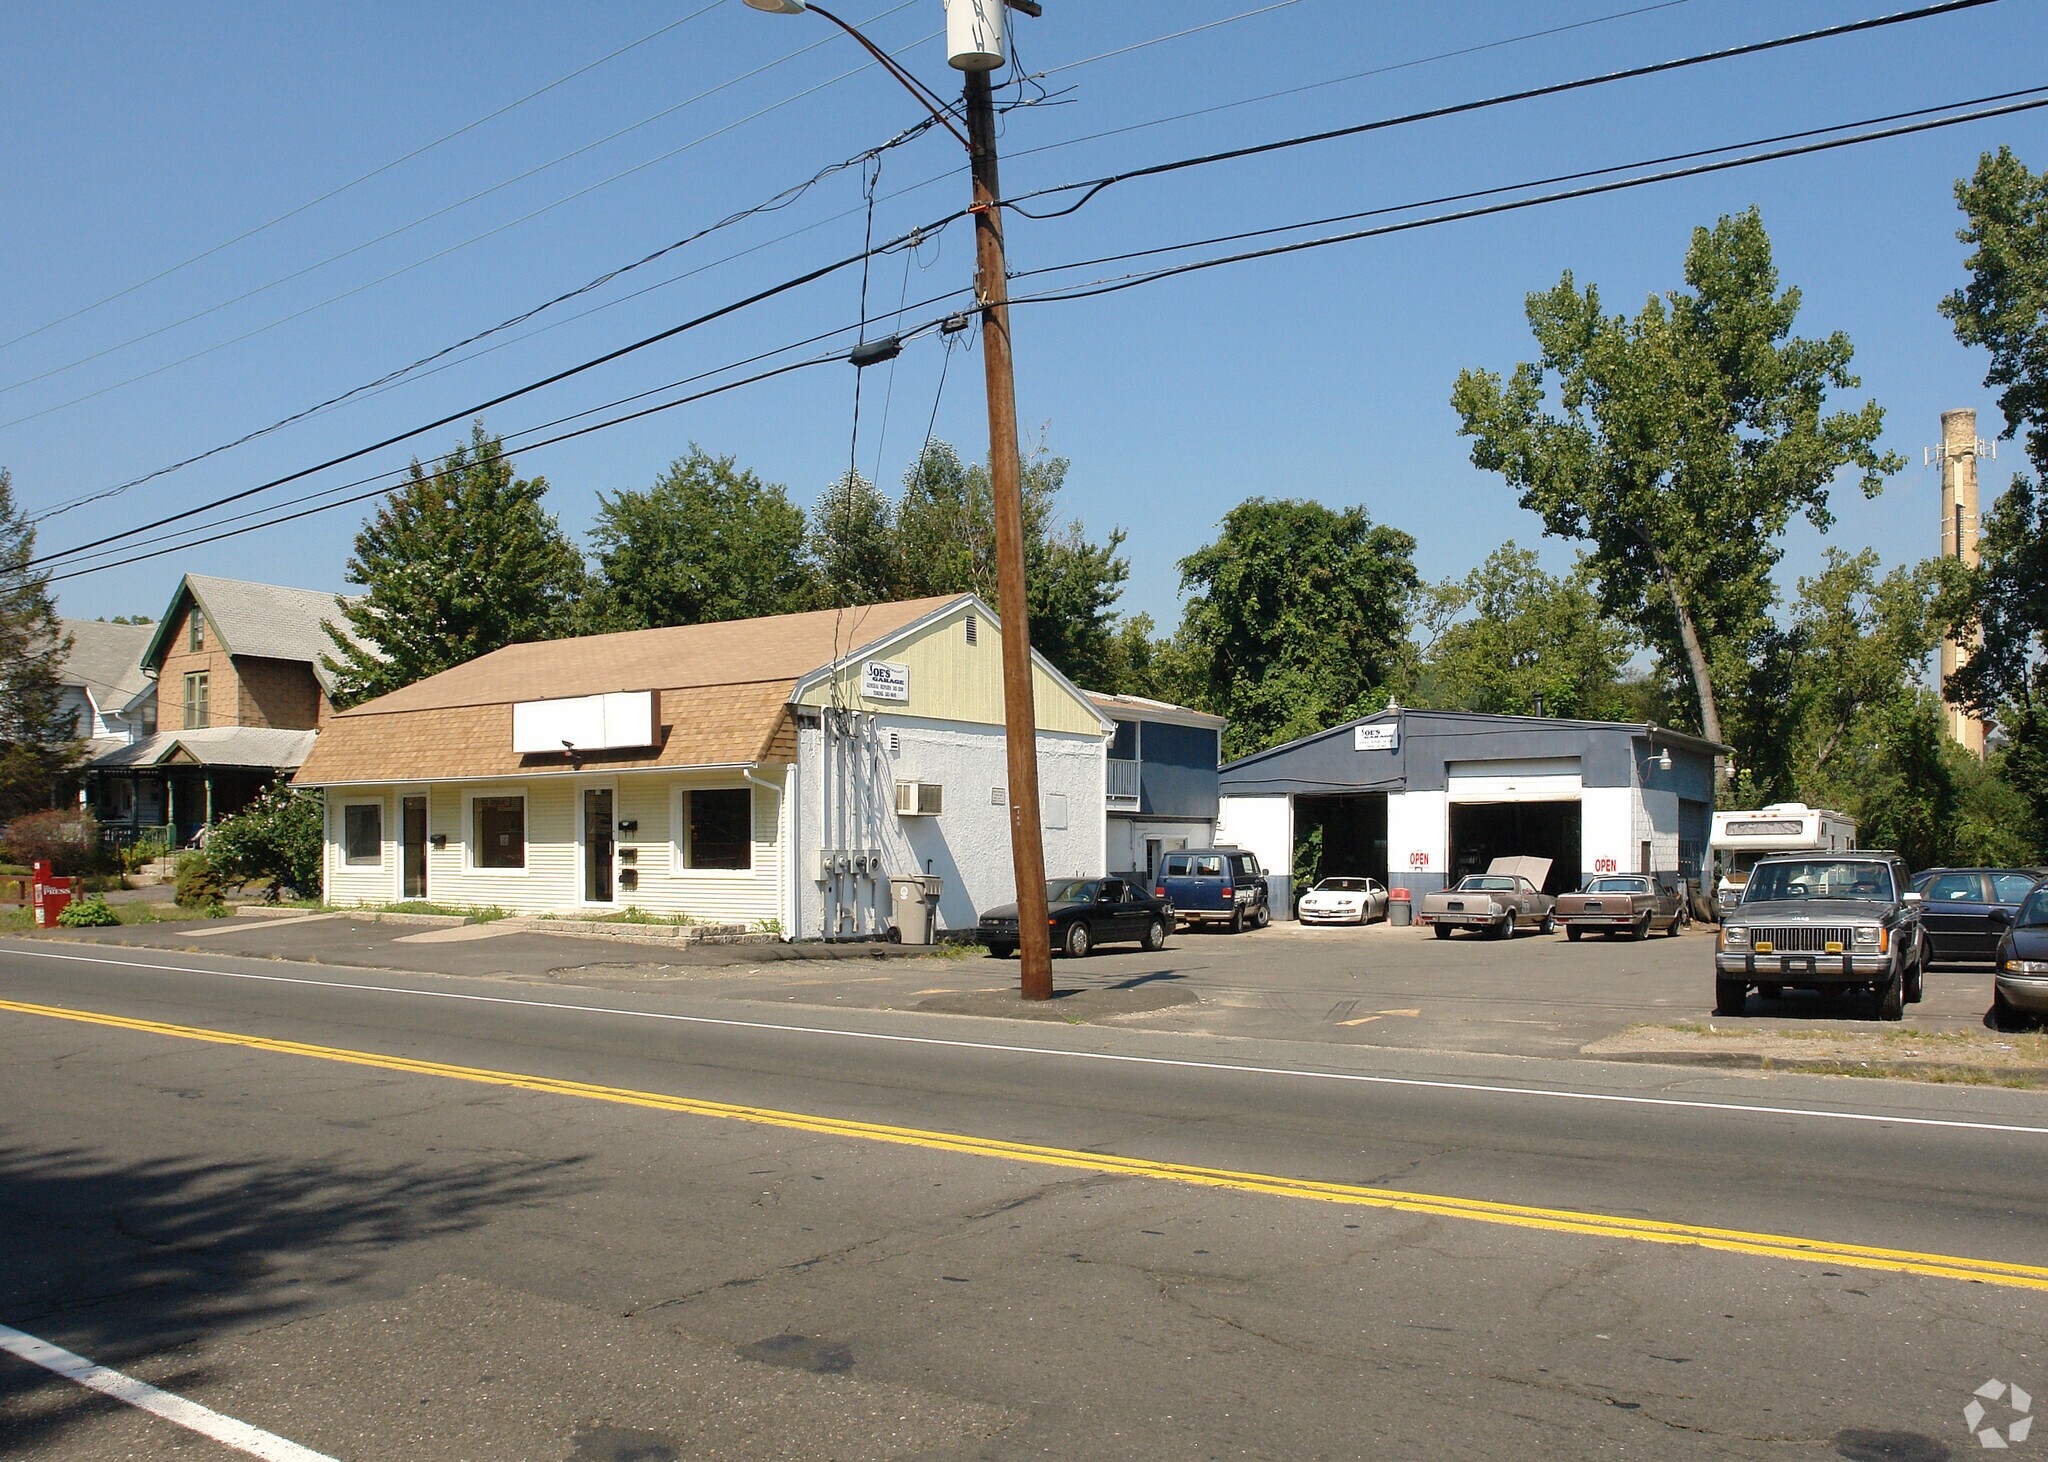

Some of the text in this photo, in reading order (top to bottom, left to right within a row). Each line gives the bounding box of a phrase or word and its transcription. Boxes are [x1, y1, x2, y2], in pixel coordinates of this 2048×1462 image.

[872, 677, 904, 685] GARAGE
[1410, 852, 1429, 865] OPEN
[1595, 859, 1616, 872] OPEN
[43, 887, 71, 896] PRESS
